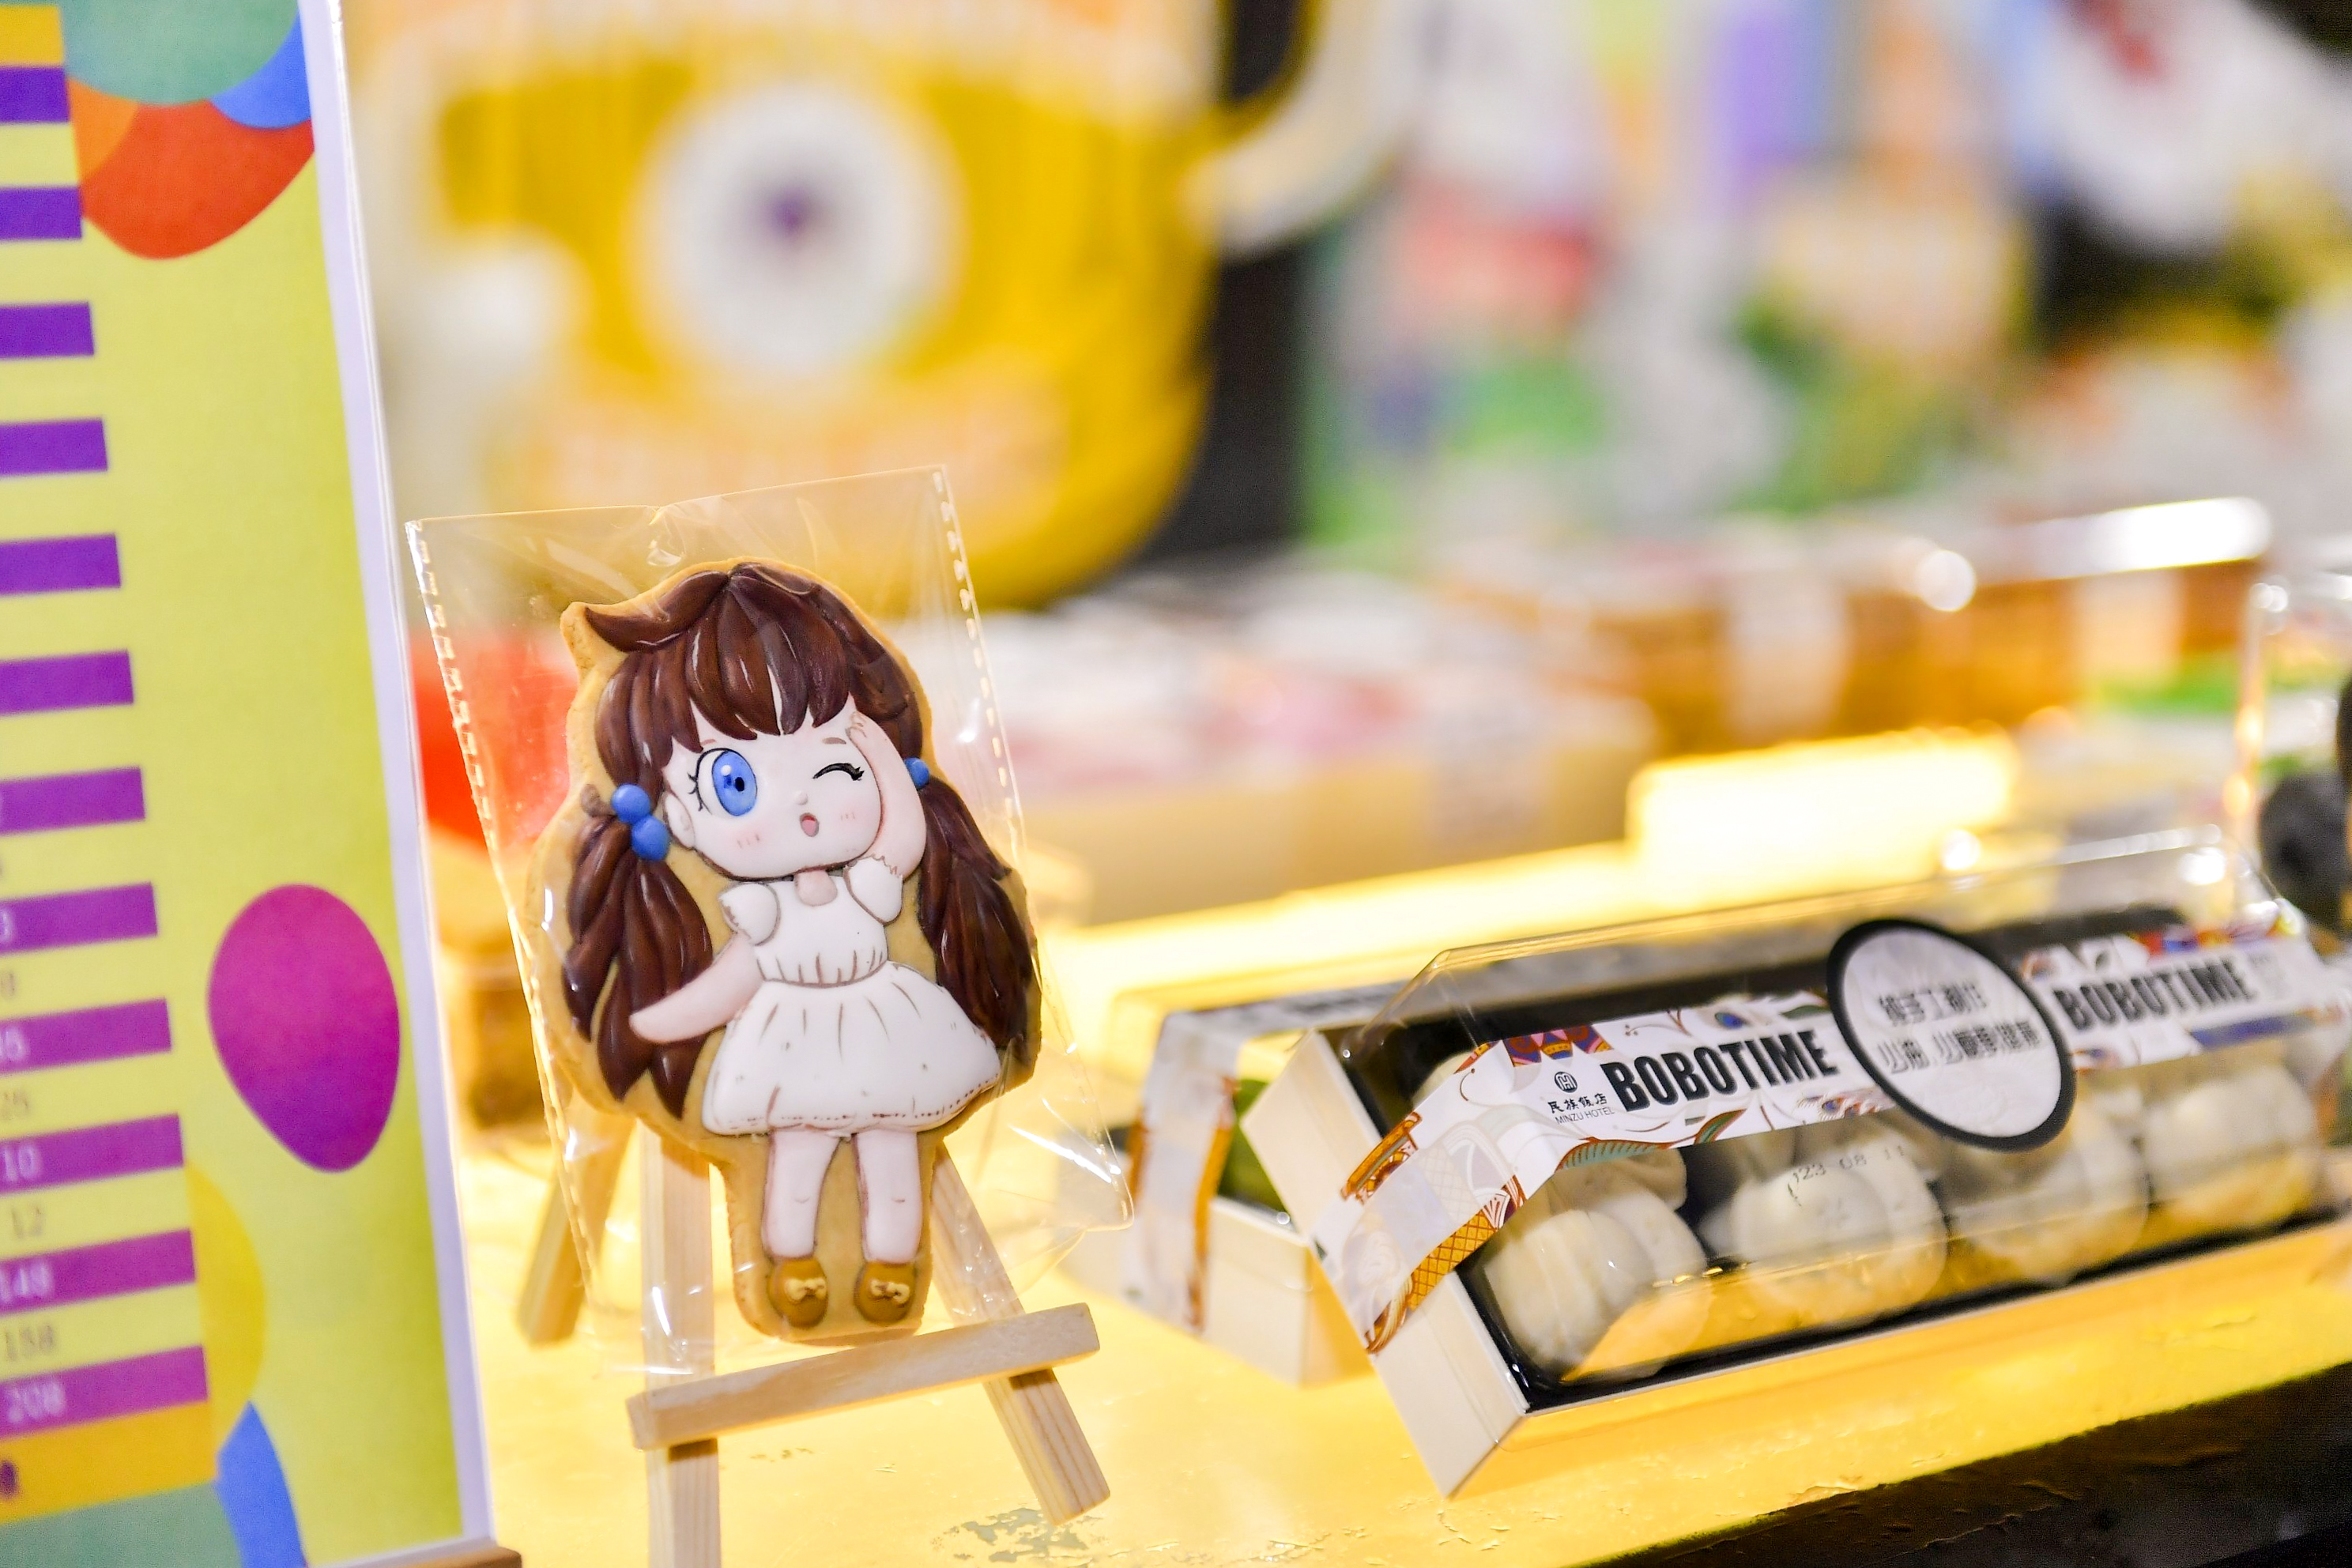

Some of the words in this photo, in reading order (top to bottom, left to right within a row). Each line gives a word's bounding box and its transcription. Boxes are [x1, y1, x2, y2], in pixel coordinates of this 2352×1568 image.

[1600, 1029, 1840, 1112] BOBOTIME
[1547, 1093, 1608, 1114] 民族飯店
[1555, 1113, 1585, 1125] MINZU
[1585, 1106, 1615, 1119] HOTEL
